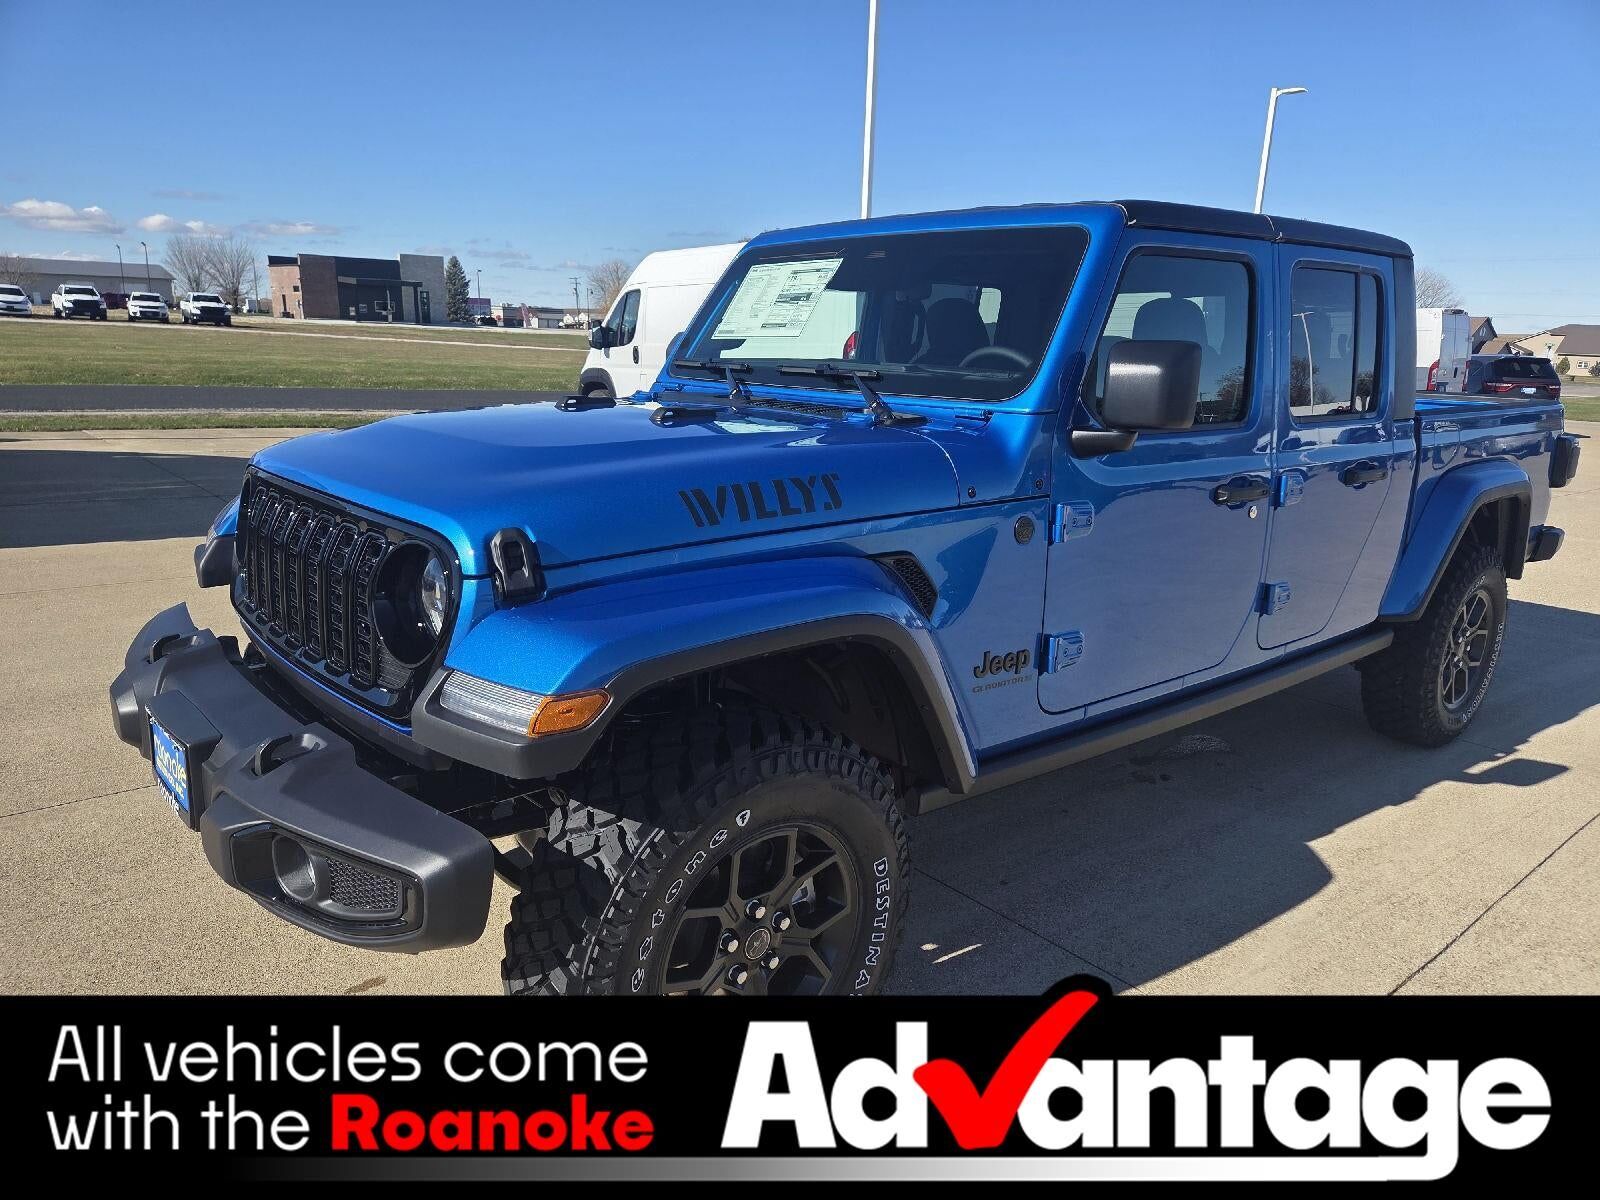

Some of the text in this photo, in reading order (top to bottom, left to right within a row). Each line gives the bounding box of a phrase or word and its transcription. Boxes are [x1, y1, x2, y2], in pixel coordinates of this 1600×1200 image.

[678, 472, 842, 527] WILLYS
[972, 676, 1025, 694] GLADIATOR
[973, 648, 1030, 679] Jeep
[850, 857, 891, 995] DESTINA
